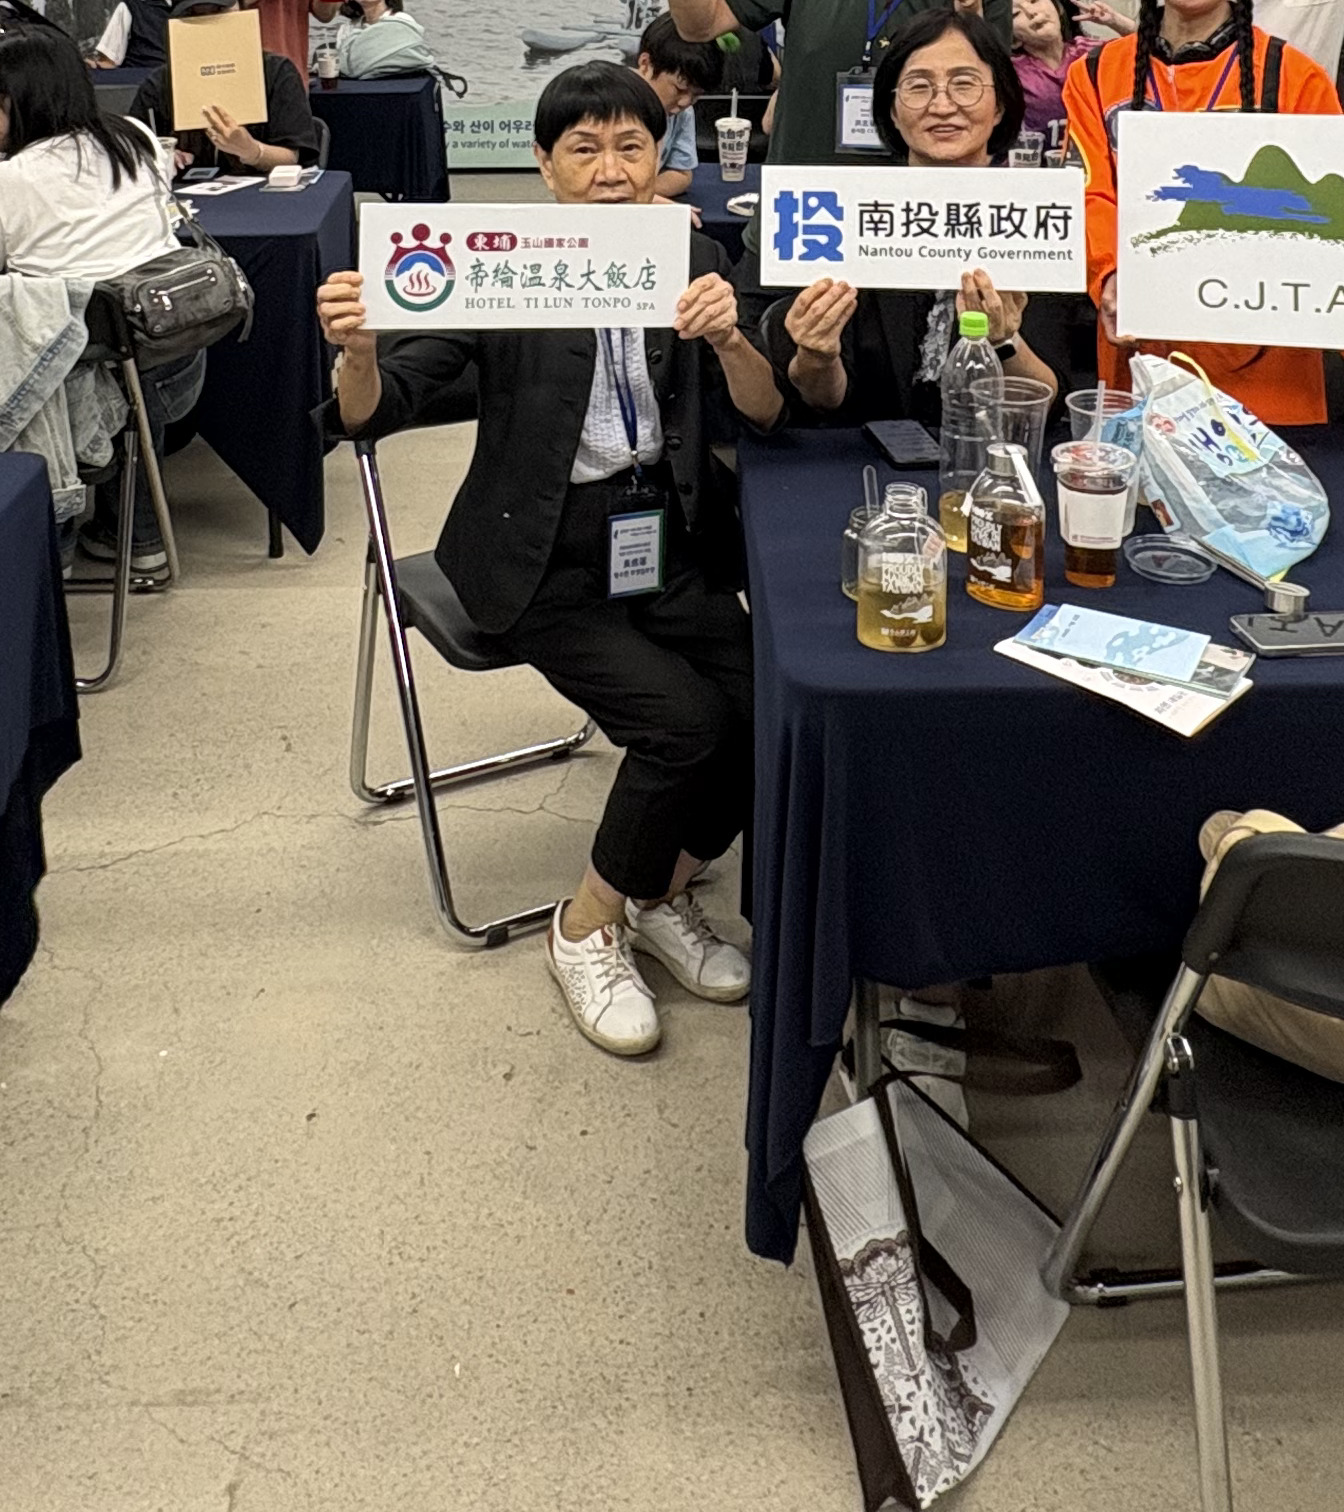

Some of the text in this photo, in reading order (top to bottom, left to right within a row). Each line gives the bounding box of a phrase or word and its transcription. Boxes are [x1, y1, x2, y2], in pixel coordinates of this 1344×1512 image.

[470, 120, 494, 134] 산이
[461, 138, 496, 151] variety
[499, 138, 510, 148] of
[858, 200, 1072, 241] 南投縣政府
[858, 245, 1073, 261] Nantou County Government
[465, 297, 515, 309] HOTEL
[543, 297, 574, 309] LUN
[581, 297, 631, 309] TONPO
